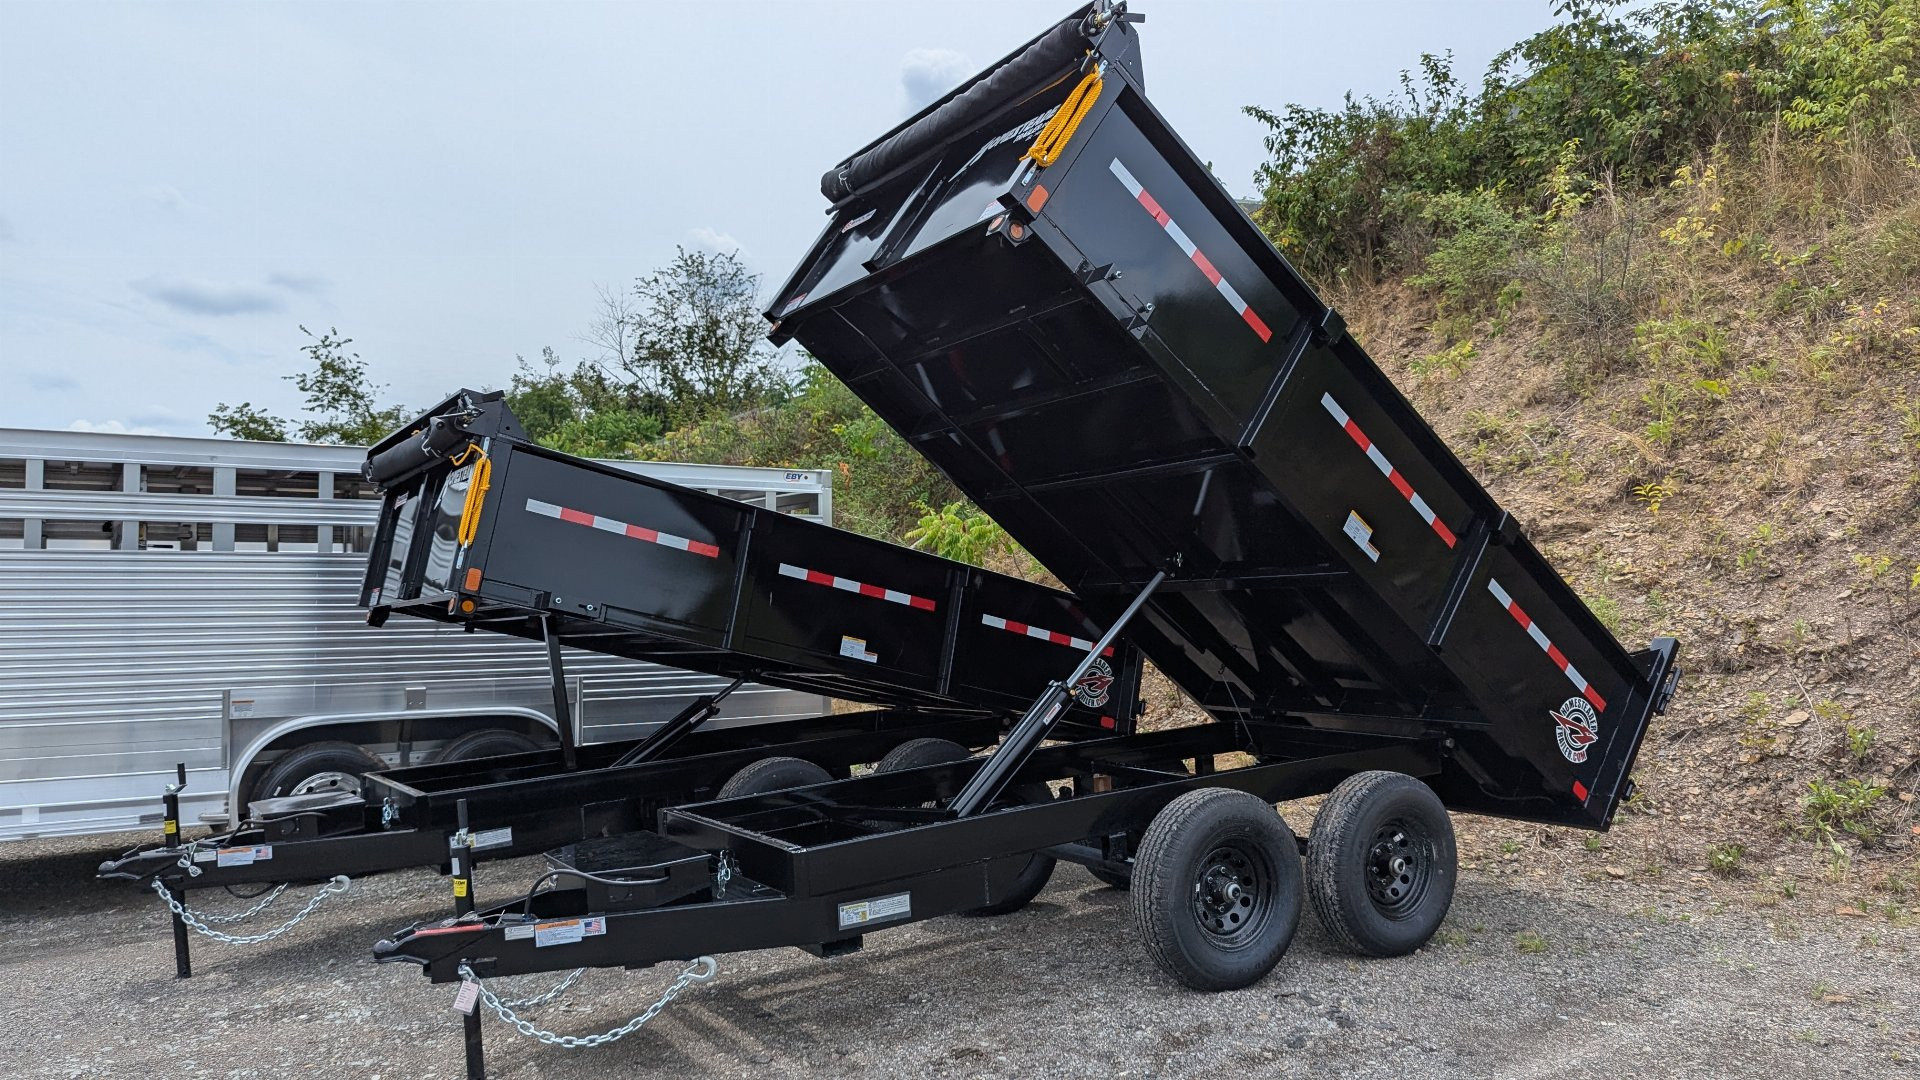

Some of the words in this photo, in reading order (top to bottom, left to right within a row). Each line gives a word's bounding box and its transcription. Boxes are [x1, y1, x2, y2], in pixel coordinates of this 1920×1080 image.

[785, 472, 804, 480] EBY
[1560, 697, 1598, 732] HOMESTEADER
[1556, 726, 1587, 762] TRAILER.COM
